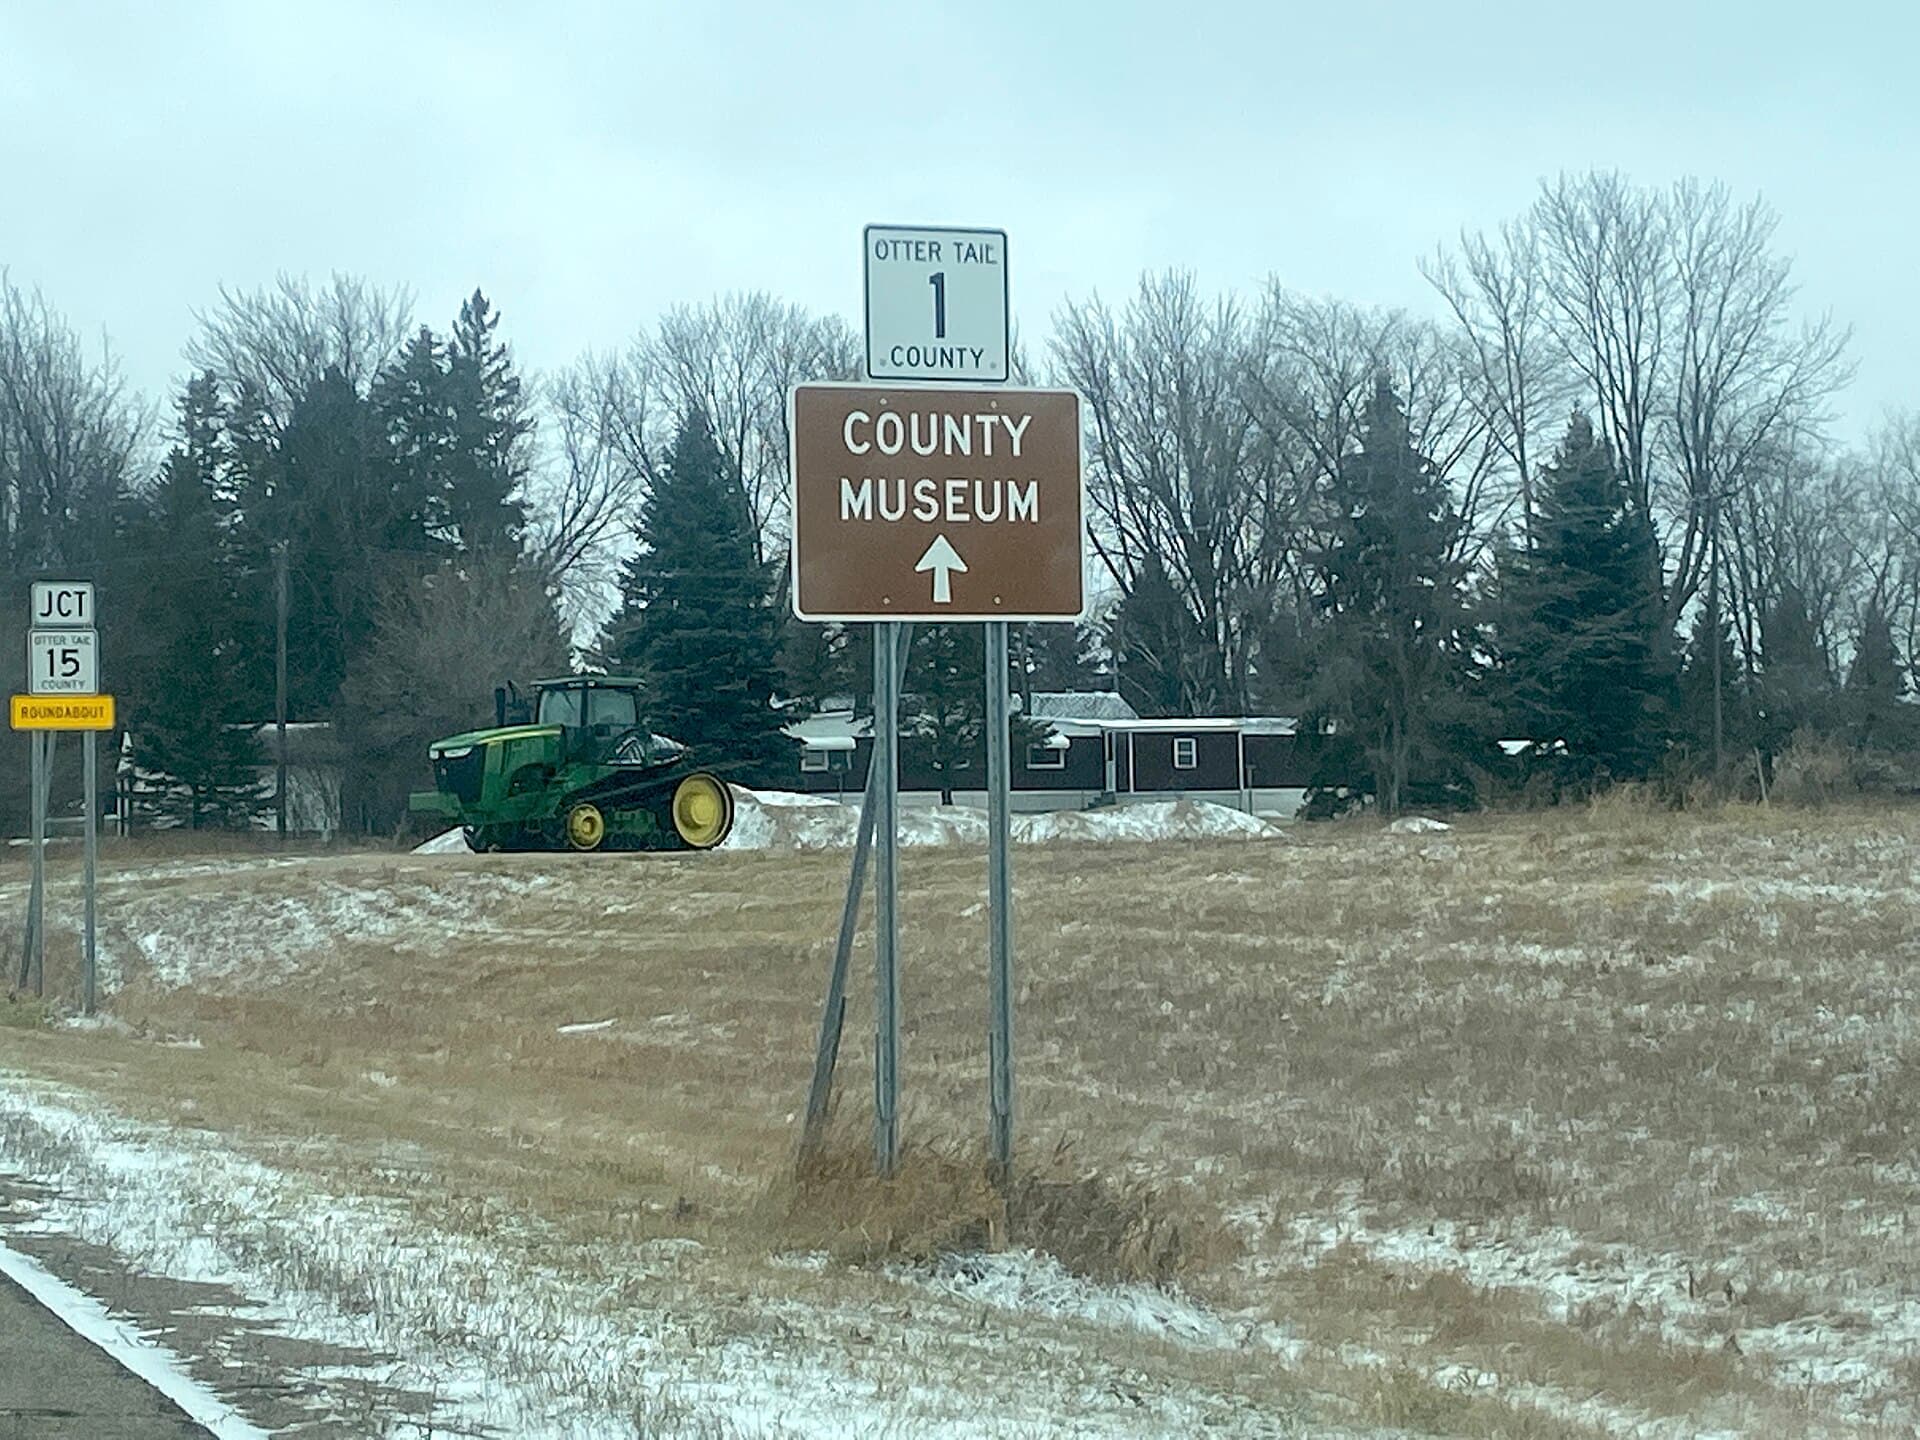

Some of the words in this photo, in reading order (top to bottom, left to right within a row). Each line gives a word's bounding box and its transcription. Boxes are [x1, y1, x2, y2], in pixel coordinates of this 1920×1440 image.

[875, 239, 941, 262] OTTER
[953, 241, 997, 264] TAIL
[929, 272, 945, 338] 1
[891, 345, 984, 368] COUNTY
[843, 411, 1032, 456] COUNTY
[841, 478, 1038, 523] MUSEUM
[39, 590, 87, 617] JCT
[34, 635, 66, 645] OTTER
[47, 648, 80, 677] 15
[41, 680, 85, 690] COUNTY
[21, 706, 104, 719] ROUNDABOUT
